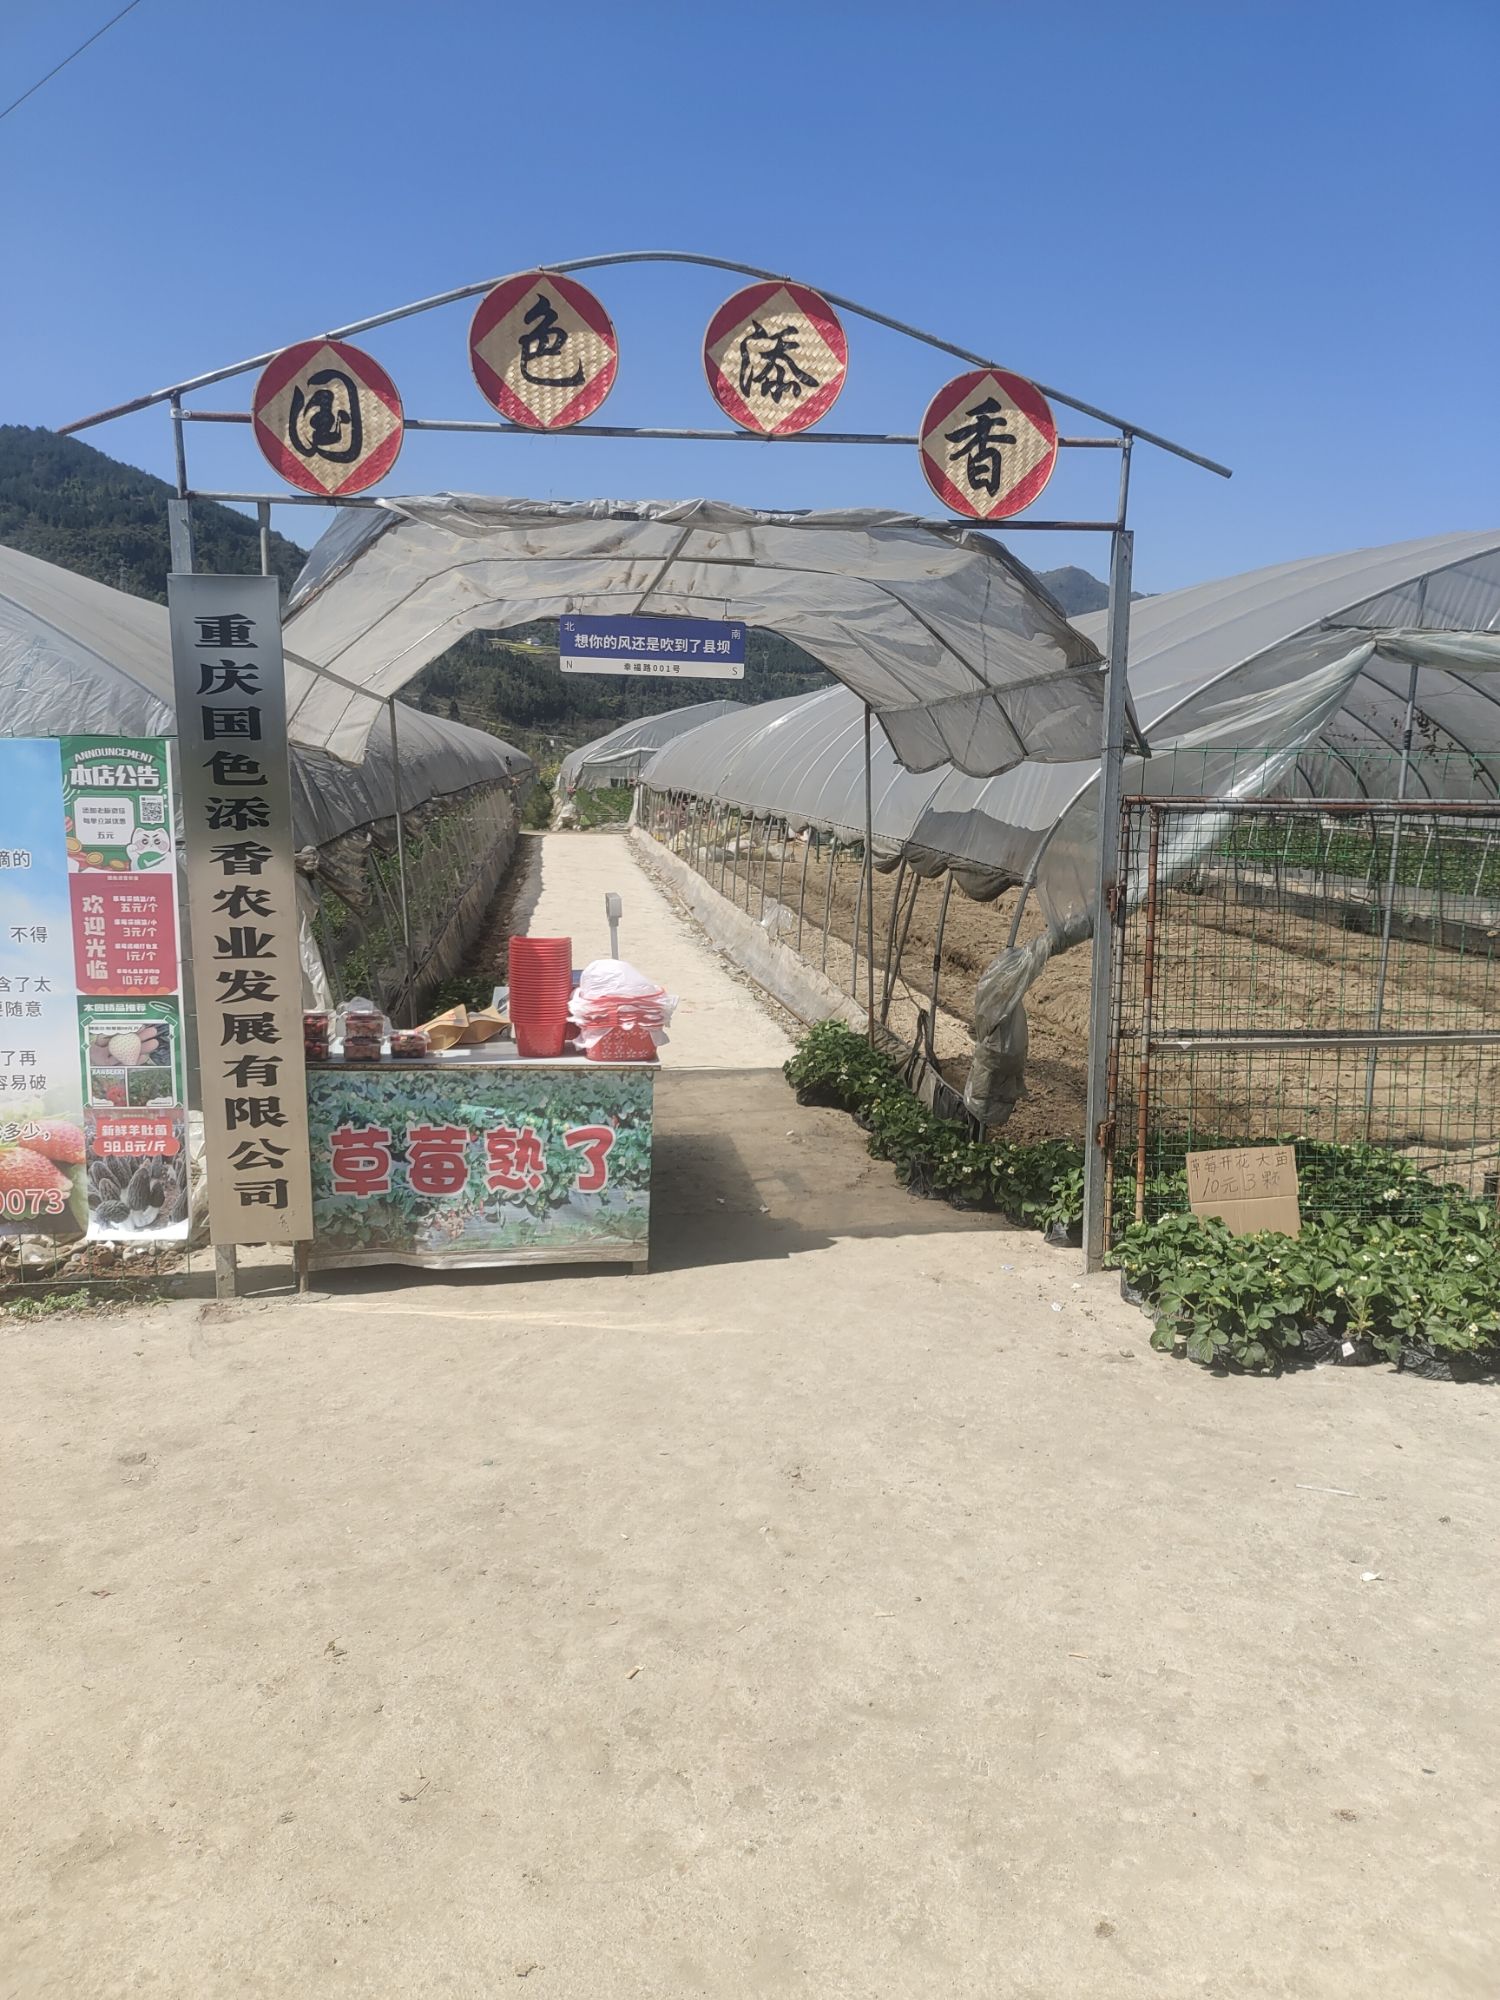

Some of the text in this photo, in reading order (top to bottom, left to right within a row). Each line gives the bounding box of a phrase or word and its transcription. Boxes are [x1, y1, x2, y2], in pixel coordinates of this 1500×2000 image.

[288, 293, 1016, 497] 国 色 添 香
[565, 621, 575, 632] 北
[731, 630, 741, 640] 南
[574, 634, 730, 655] 想你的风还是吹到了县坝
[566, 661, 573, 669] N
[624, 663, 680, 673] 幸福路001号
[732, 667, 738, 675] S
[75, 747, 154, 763] ANNOUNCEMENT
[69, 763, 160, 787] 本店公告
[121, 903, 158, 913] 五元/个
[193, 613, 289, 1209] 重庆国色添香农业发展有限公司
[10, 926, 48, 943] 不得
[82, 895, 108, 979] 欢迎光临
[123, 928, 157, 937] 3元/个
[126, 951, 156, 961] 1元/个
[0, 1000, 43, 1018] 随意
[3, 1050, 37, 1067] 了再
[101, 1125, 167, 1137] 新鲜羊肚菌
[103, 1141, 167, 1152] 98.8元/斤
[329, 1122, 616, 1197] 草莓熟了
[1190, 1152, 1288, 1179] 草莓开花大苗
[0, 1188, 65, 1214] 073
